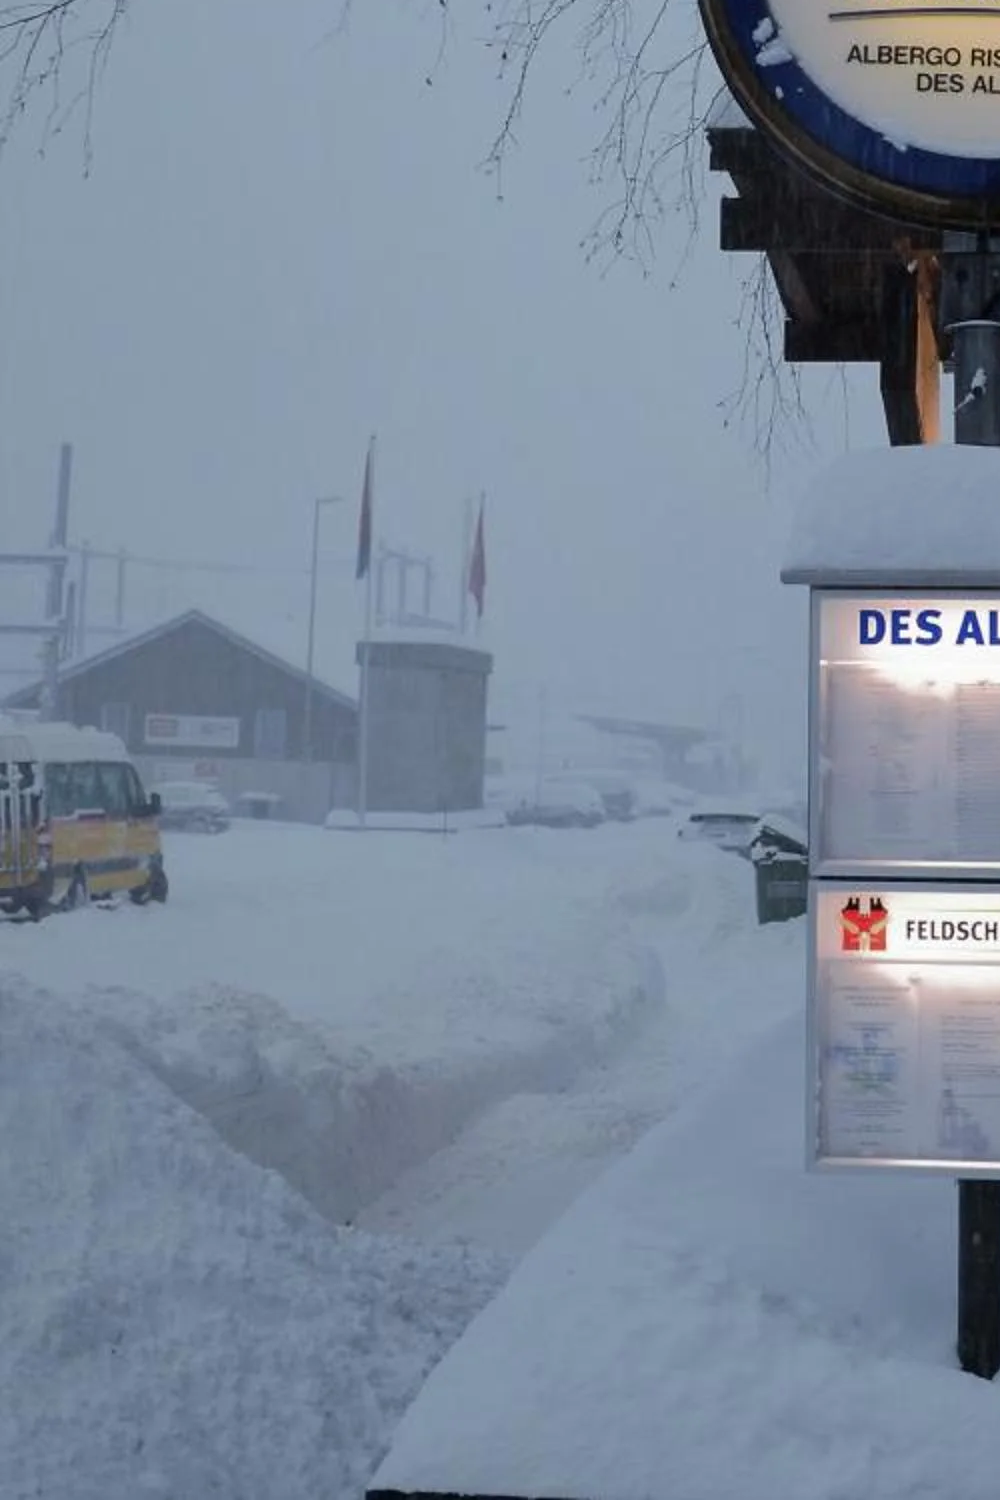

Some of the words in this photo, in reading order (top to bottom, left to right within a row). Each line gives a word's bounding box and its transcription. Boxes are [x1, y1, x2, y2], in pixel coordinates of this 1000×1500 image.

[847, 45, 962, 67] ALBERGO
[916, 73, 964, 94] DES
[859, 609, 943, 646] DES
